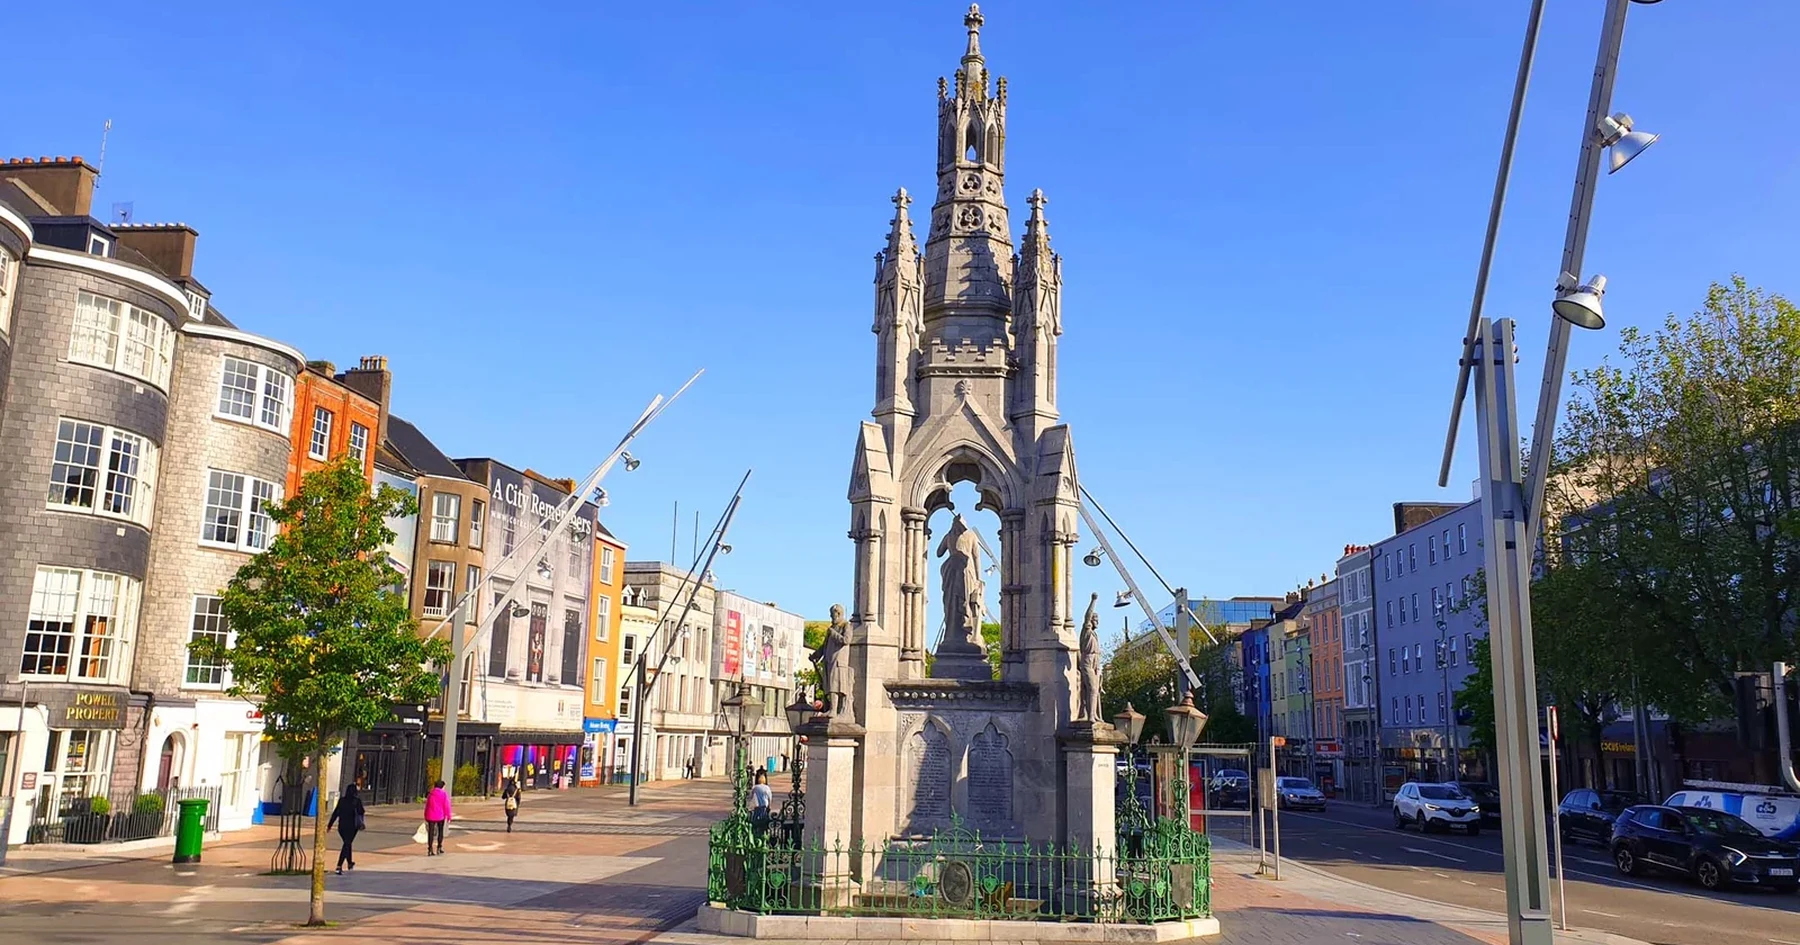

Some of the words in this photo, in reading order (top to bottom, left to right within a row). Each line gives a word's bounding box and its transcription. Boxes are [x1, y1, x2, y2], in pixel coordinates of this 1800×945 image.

[492, 478, 503, 501] A
[505, 482, 529, 515] City
[75, 692, 117, 706] POWELL
